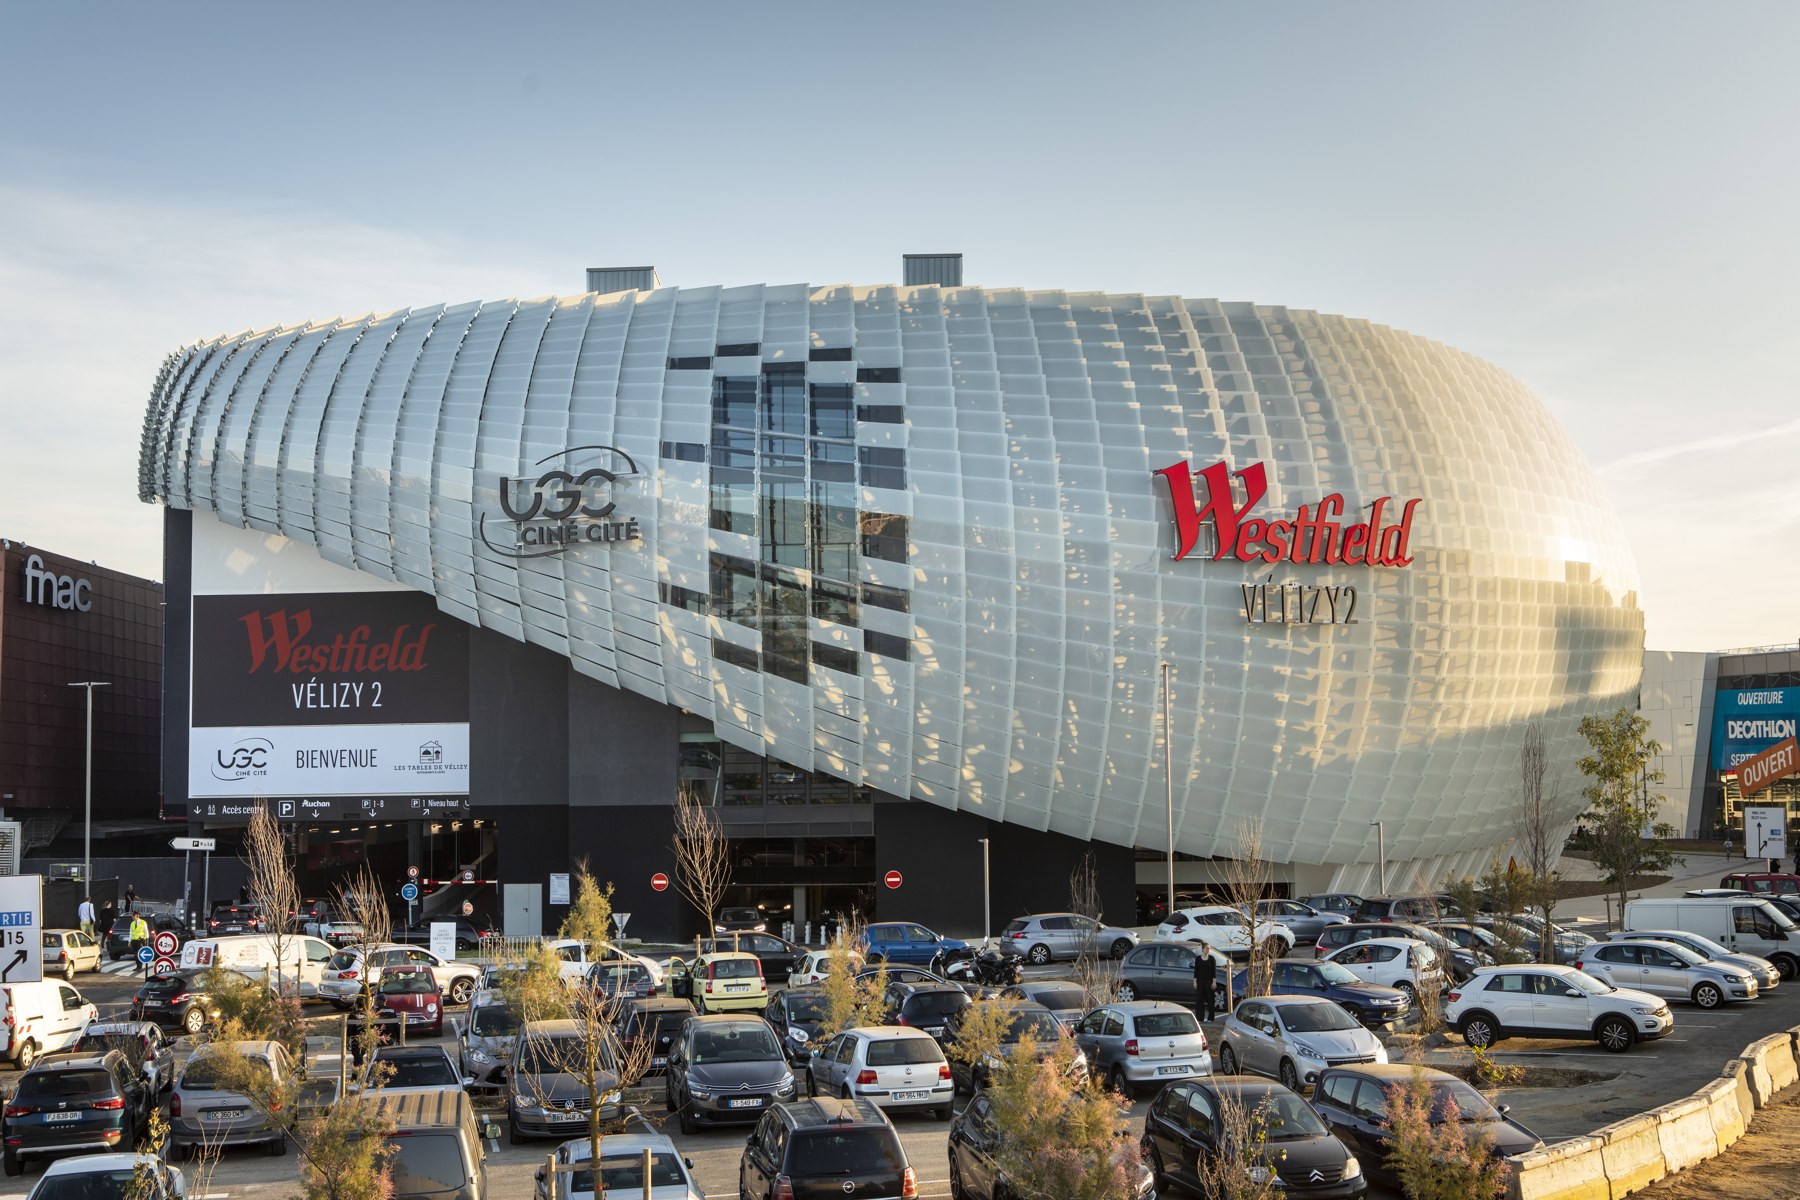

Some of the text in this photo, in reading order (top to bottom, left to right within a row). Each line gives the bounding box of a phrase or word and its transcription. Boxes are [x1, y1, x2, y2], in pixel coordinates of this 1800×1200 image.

[500, 468, 617, 522] UGC
[1154, 460, 1423, 568] Westfield
[520, 517, 639, 545] CINÉ CITÉ
[25, 554, 93, 612] fnac
[238, 608, 438, 674] Westfield
[291, 677, 383, 709] VÉLIZY 2
[1737, 691, 1784, 705] OUVERTURE
[1727, 720, 1796, 739] DECATHLON
[217, 747, 268, 769] UGC
[296, 749, 379, 769] BIENVENUE
[1743, 745, 1794, 787] OUVERT
[222, 804, 242, 815] Accès
[282, 803, 292, 815] P
[301, 799, 331, 808] Auchan
[428, 799, 446, 807] Niveau
[446, 799, 459, 807] haut
[2, 912, 31, 925] RTIE
[7, 931, 25, 945] 15
[157, 964, 172, 973] 20
